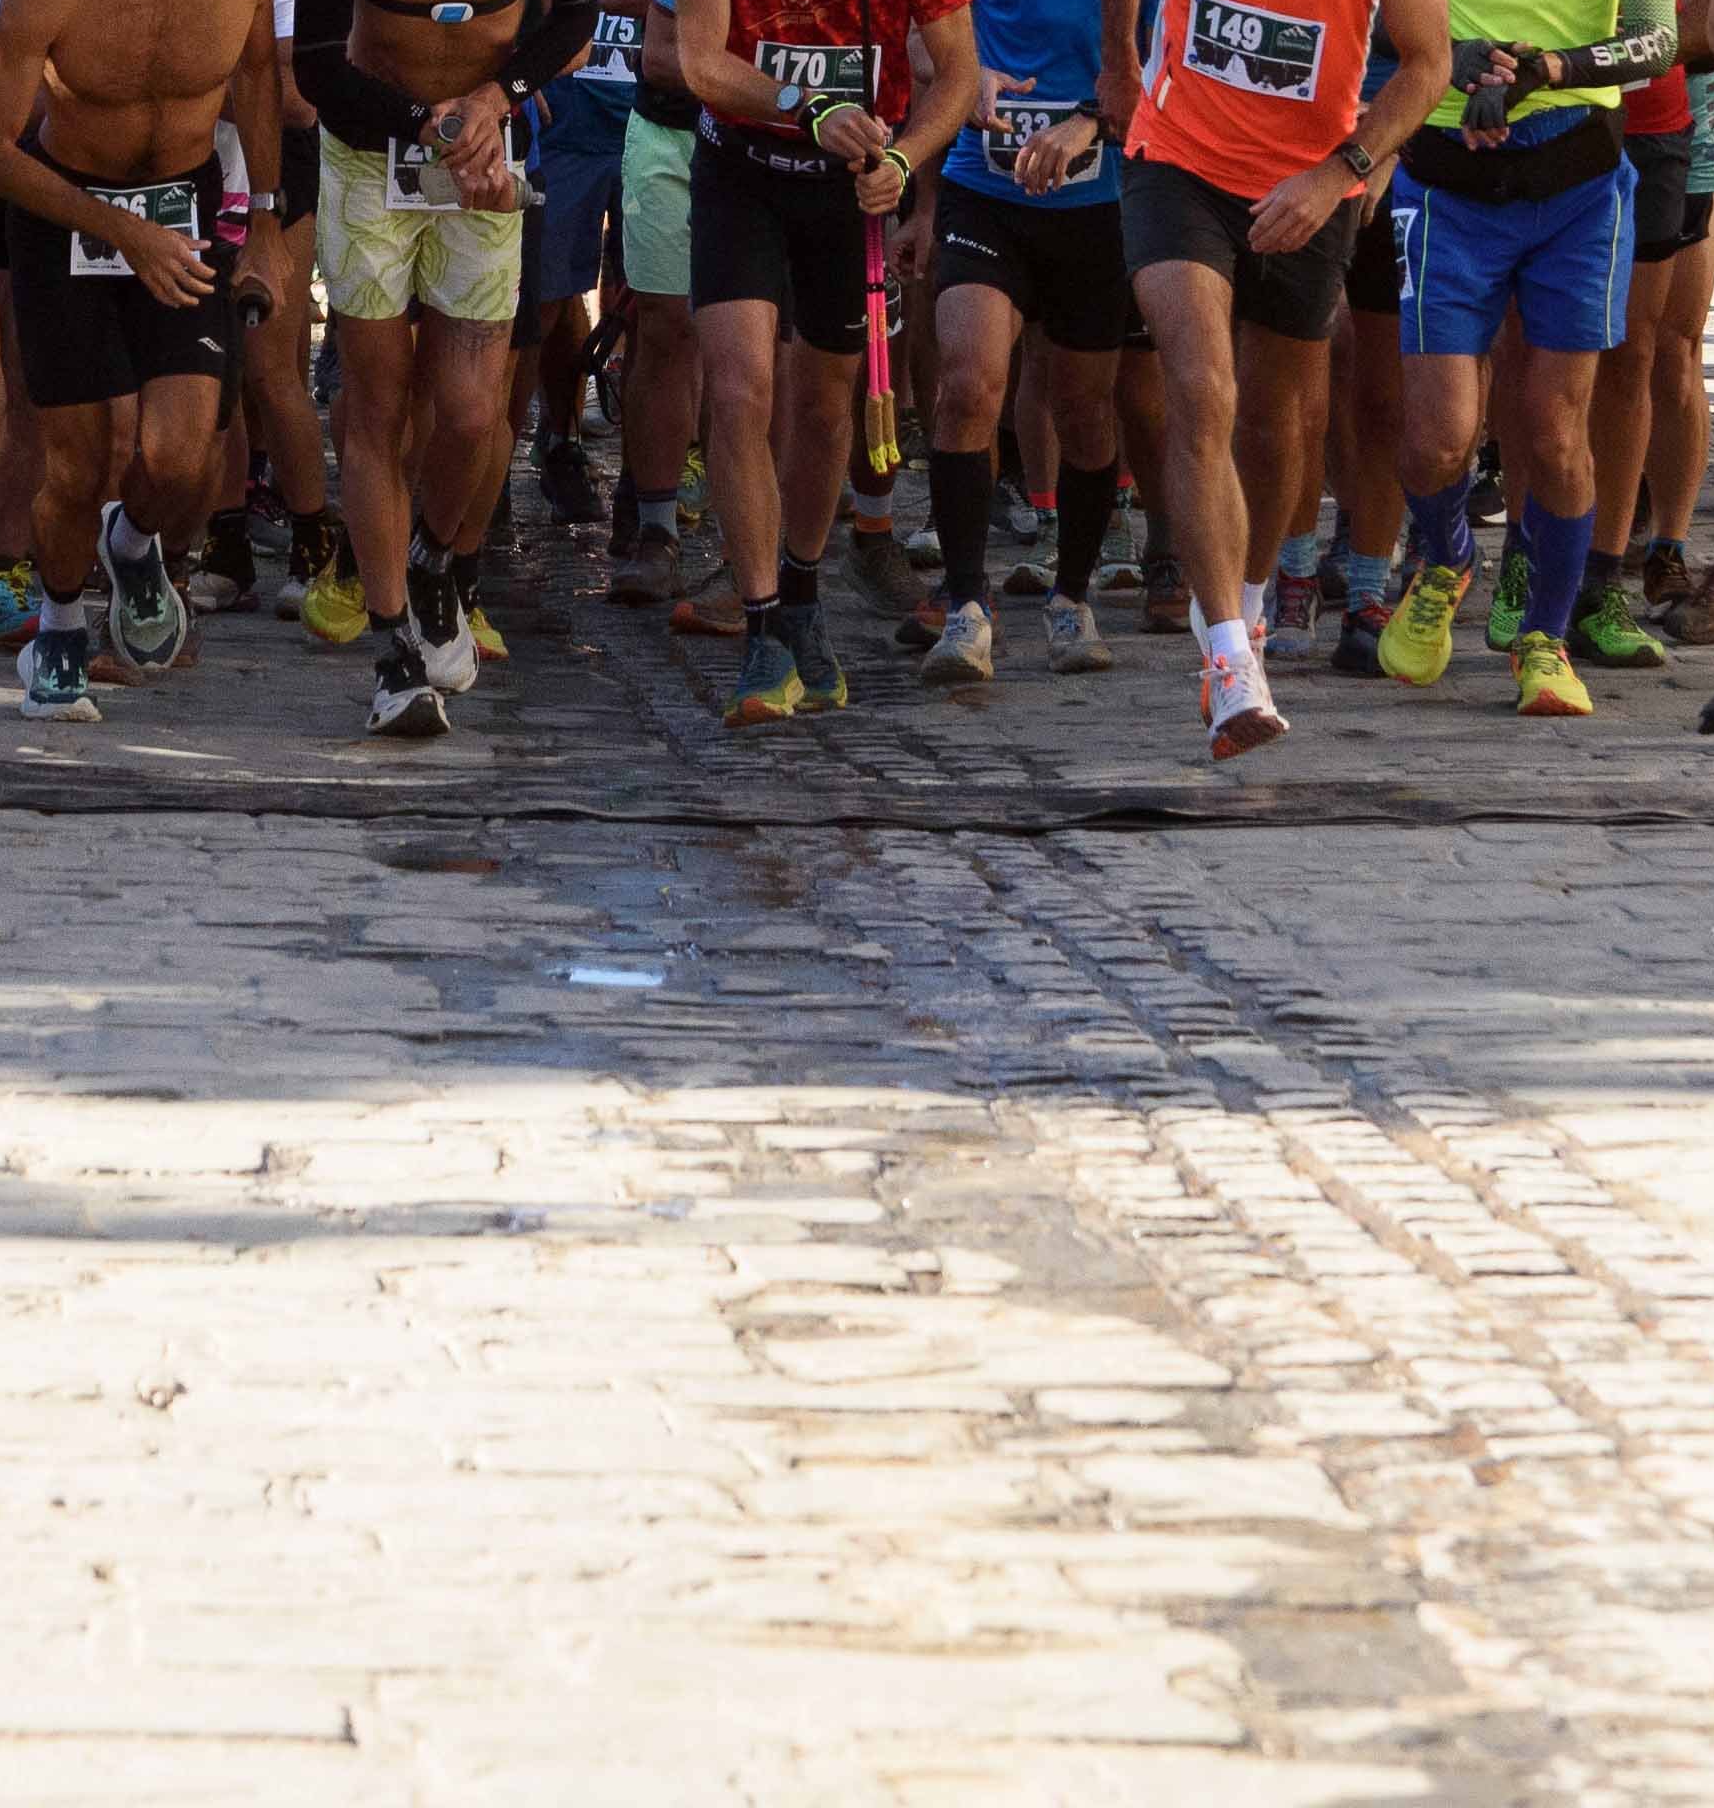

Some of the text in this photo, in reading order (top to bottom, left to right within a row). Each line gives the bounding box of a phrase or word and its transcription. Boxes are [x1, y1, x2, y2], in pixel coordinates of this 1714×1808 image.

[593, 11, 635, 44] 175
[1205, 5, 1264, 52] 149
[771, 48, 827, 88] 170
[747, 144, 827, 173] LEKI
